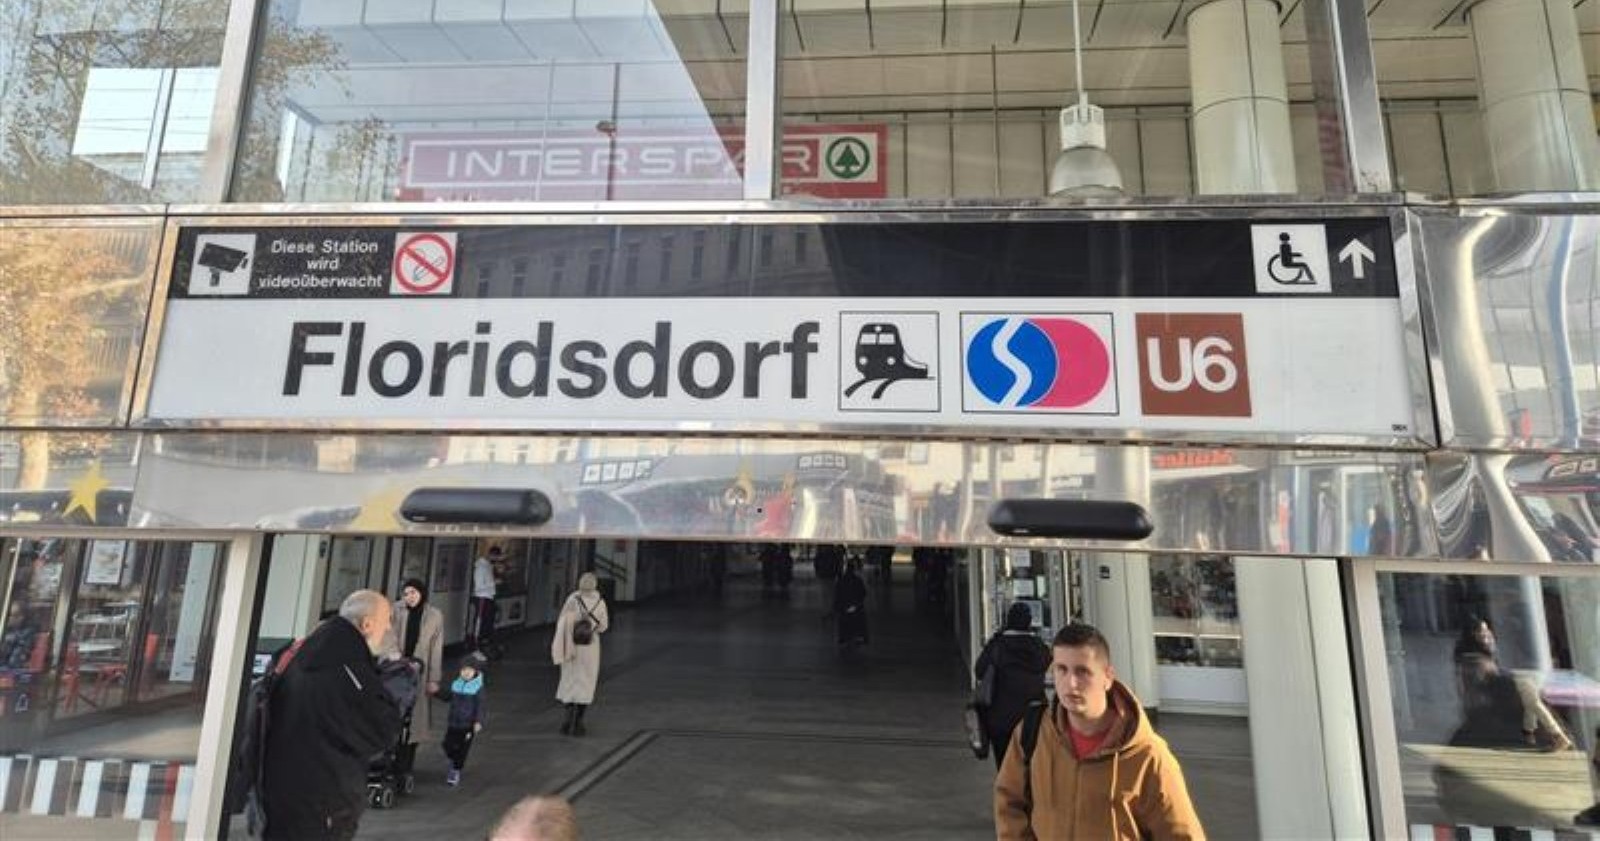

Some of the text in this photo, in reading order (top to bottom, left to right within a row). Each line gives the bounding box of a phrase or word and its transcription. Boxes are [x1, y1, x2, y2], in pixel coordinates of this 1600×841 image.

[271, 240, 378, 253] Diese Station
[307, 257, 340, 271] wird
[259, 274, 383, 288] videoüberwacht
[282, 321, 820, 399] Floridsdorf
[1147, 336, 1238, 393] U6
